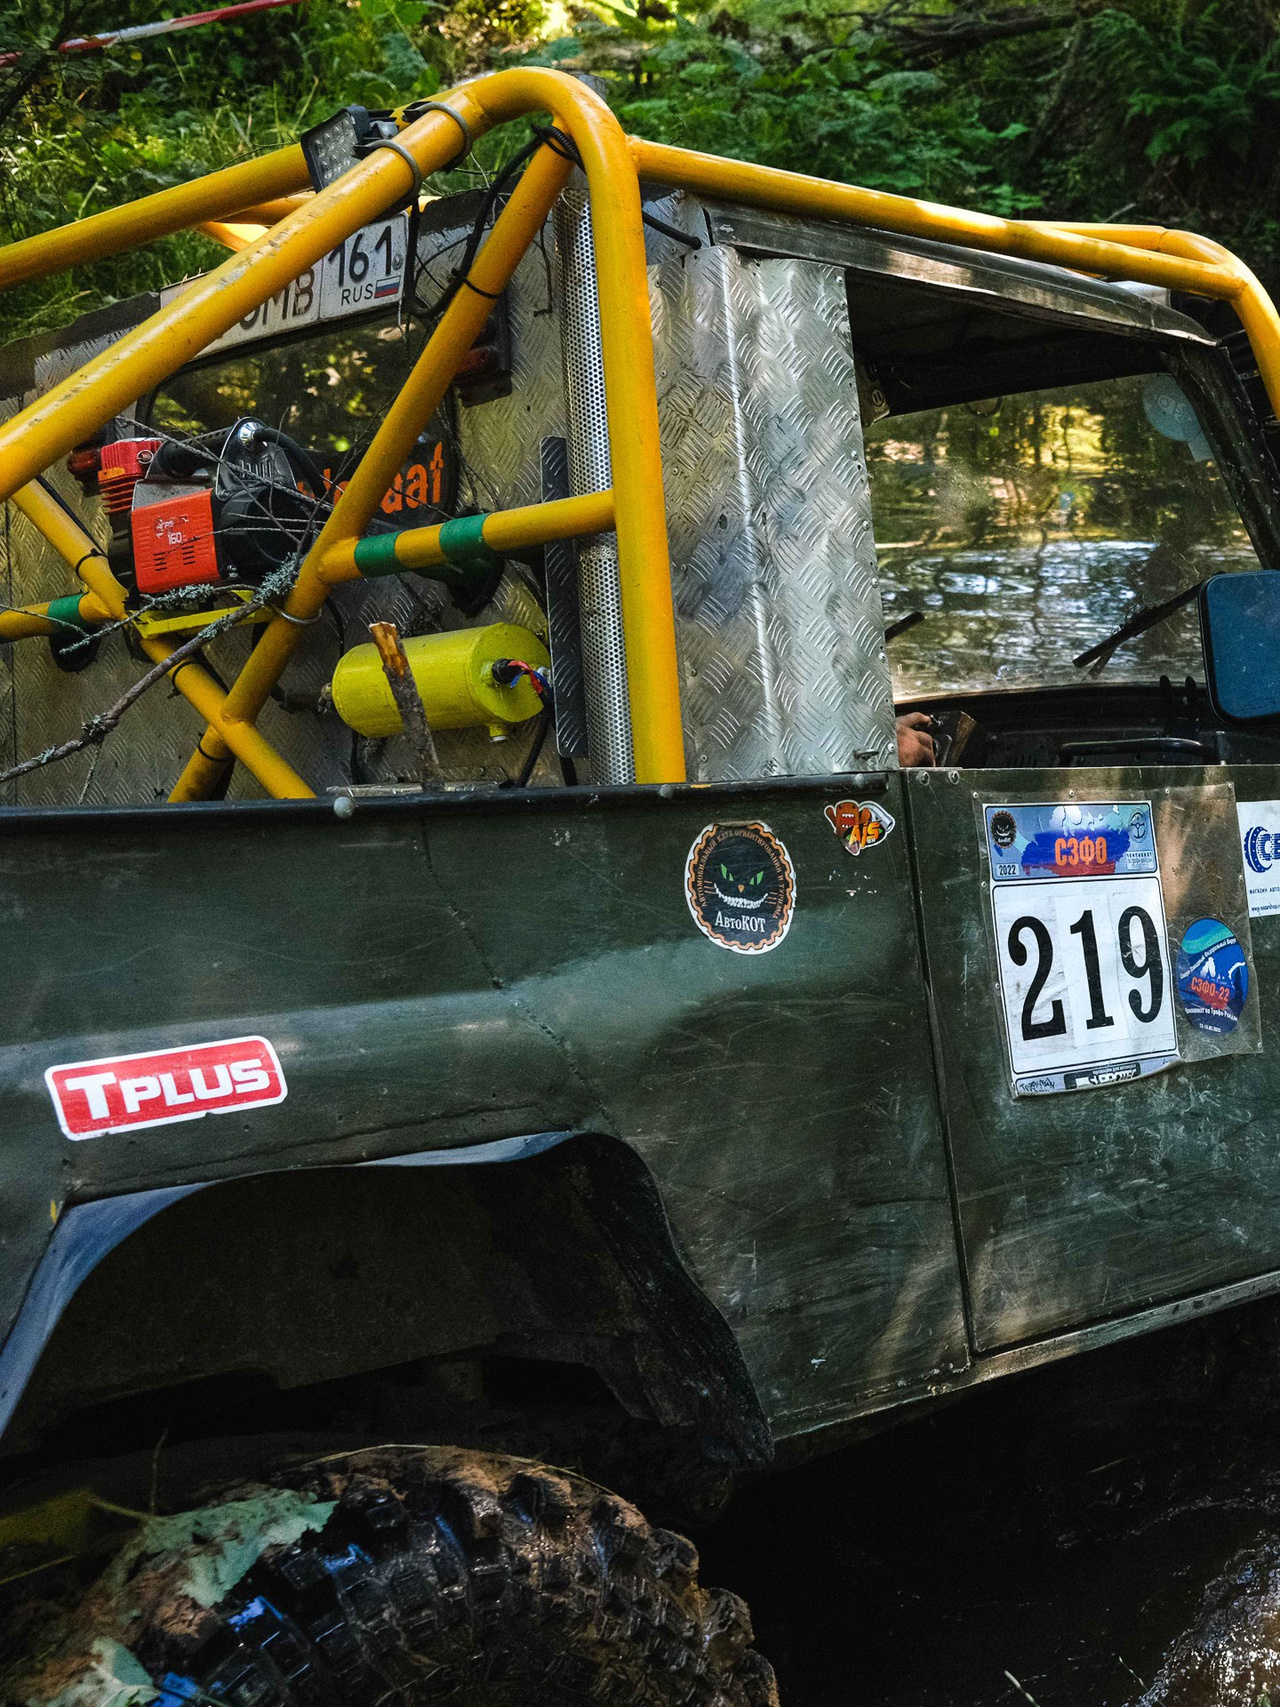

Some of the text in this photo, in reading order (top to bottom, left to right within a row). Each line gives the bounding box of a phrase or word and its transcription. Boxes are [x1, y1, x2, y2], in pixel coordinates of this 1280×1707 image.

[328, 225, 393, 287] 161
[340, 283, 374, 306] RUS
[1055, 836, 1107, 867] СЗФО
[999, 864, 1017, 876] 2022
[714, 911, 766, 933] АвтоКОТ
[1007, 905, 1165, 1042] 219
[1191, 976, 1230, 1002] СЗФО-22
